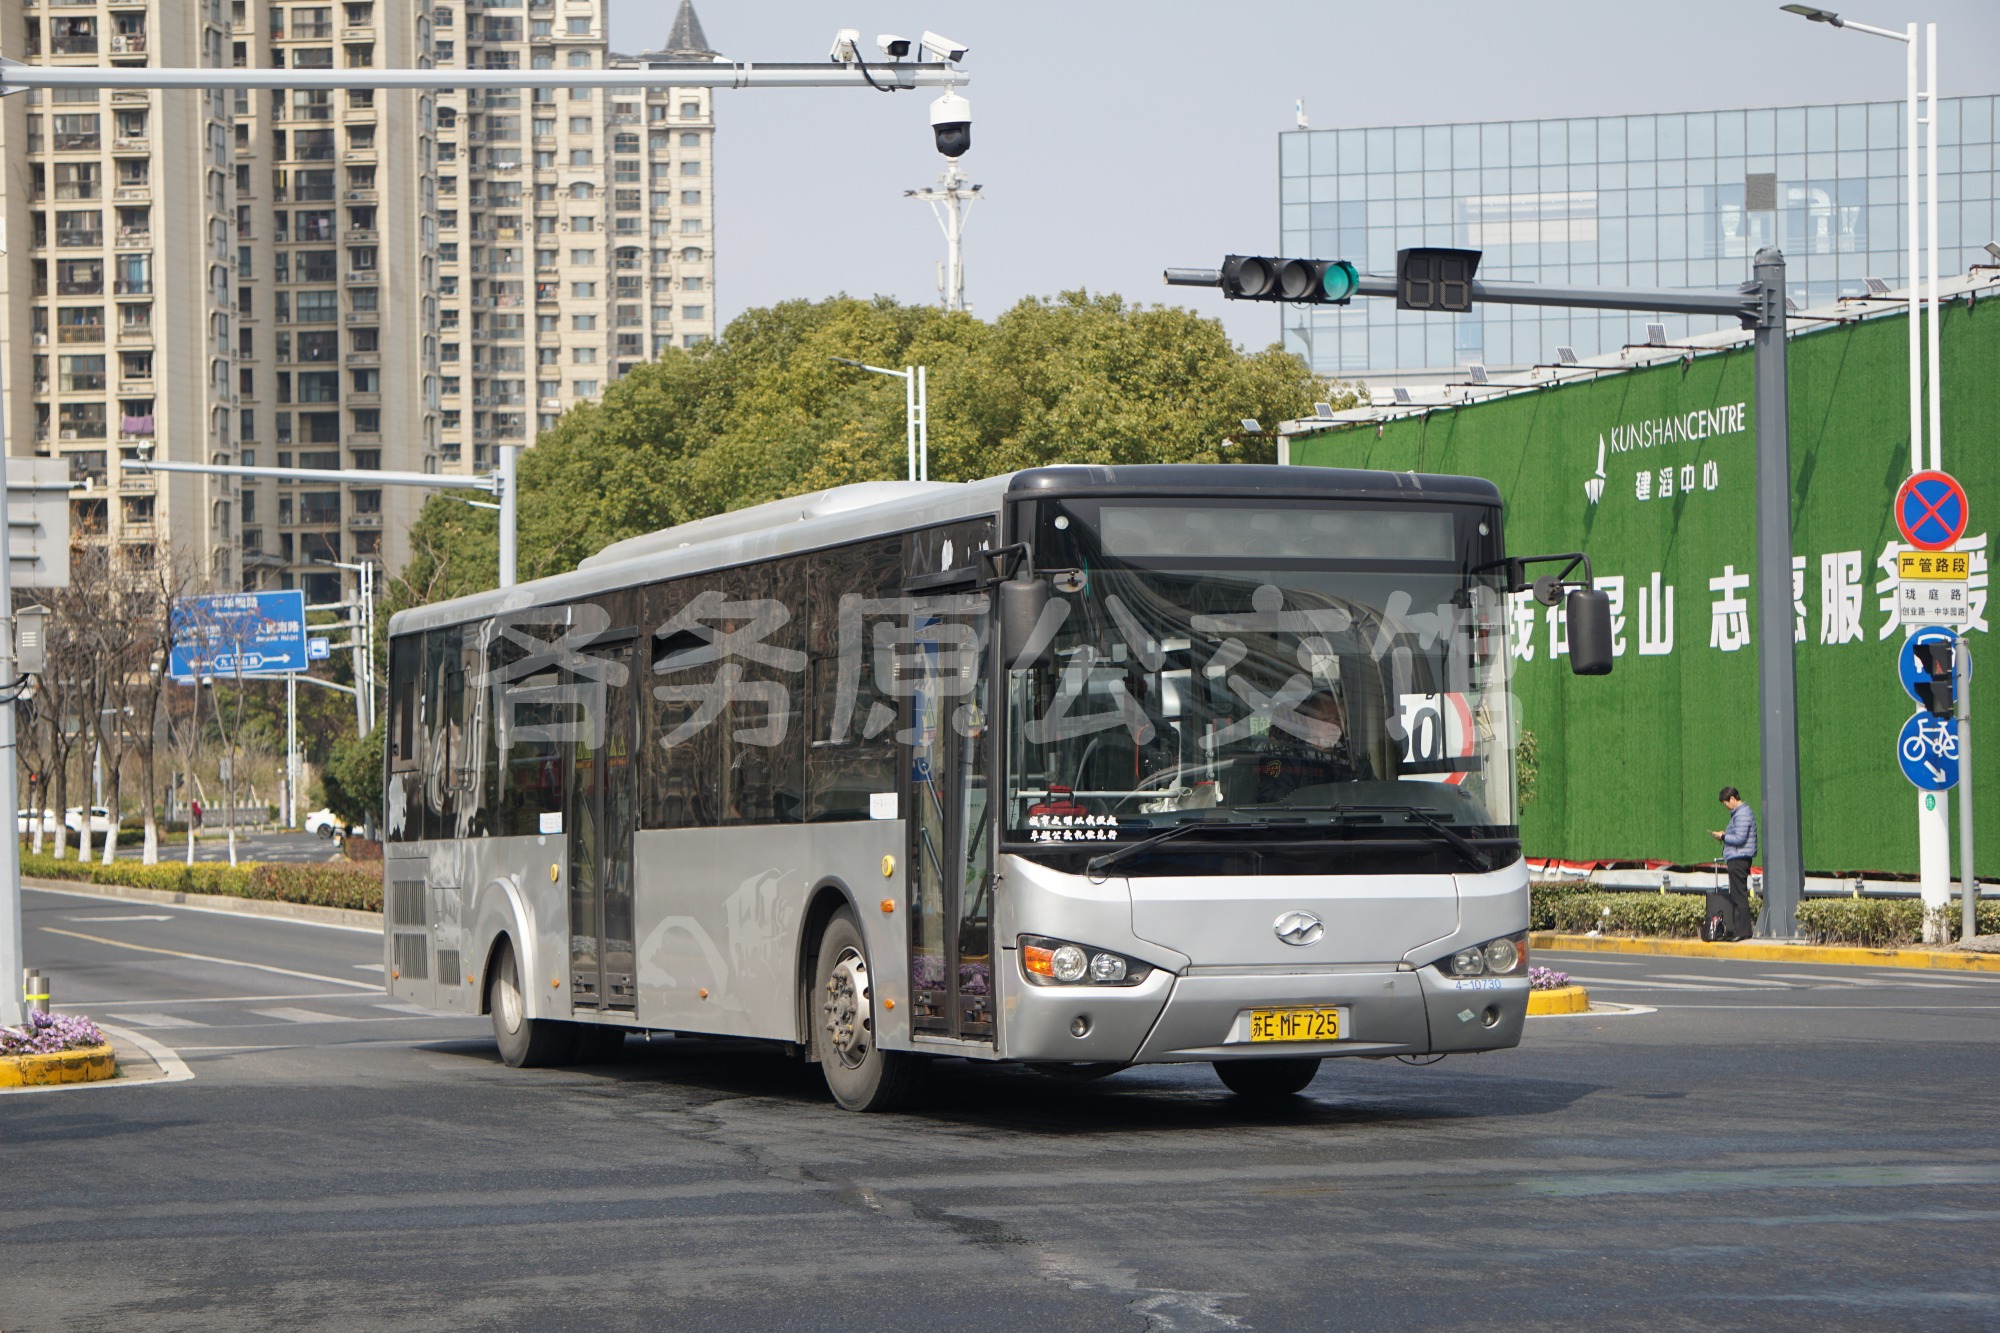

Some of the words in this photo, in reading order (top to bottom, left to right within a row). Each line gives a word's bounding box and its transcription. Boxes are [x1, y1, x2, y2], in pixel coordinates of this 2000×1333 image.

[1635, 459, 1719, 501] 建滔中心
[1902, 557, 1966, 573] 严管路段
[1905, 588, 1961, 601] 珑庭路
[1455, 979, 1502, 990] 4-10730
